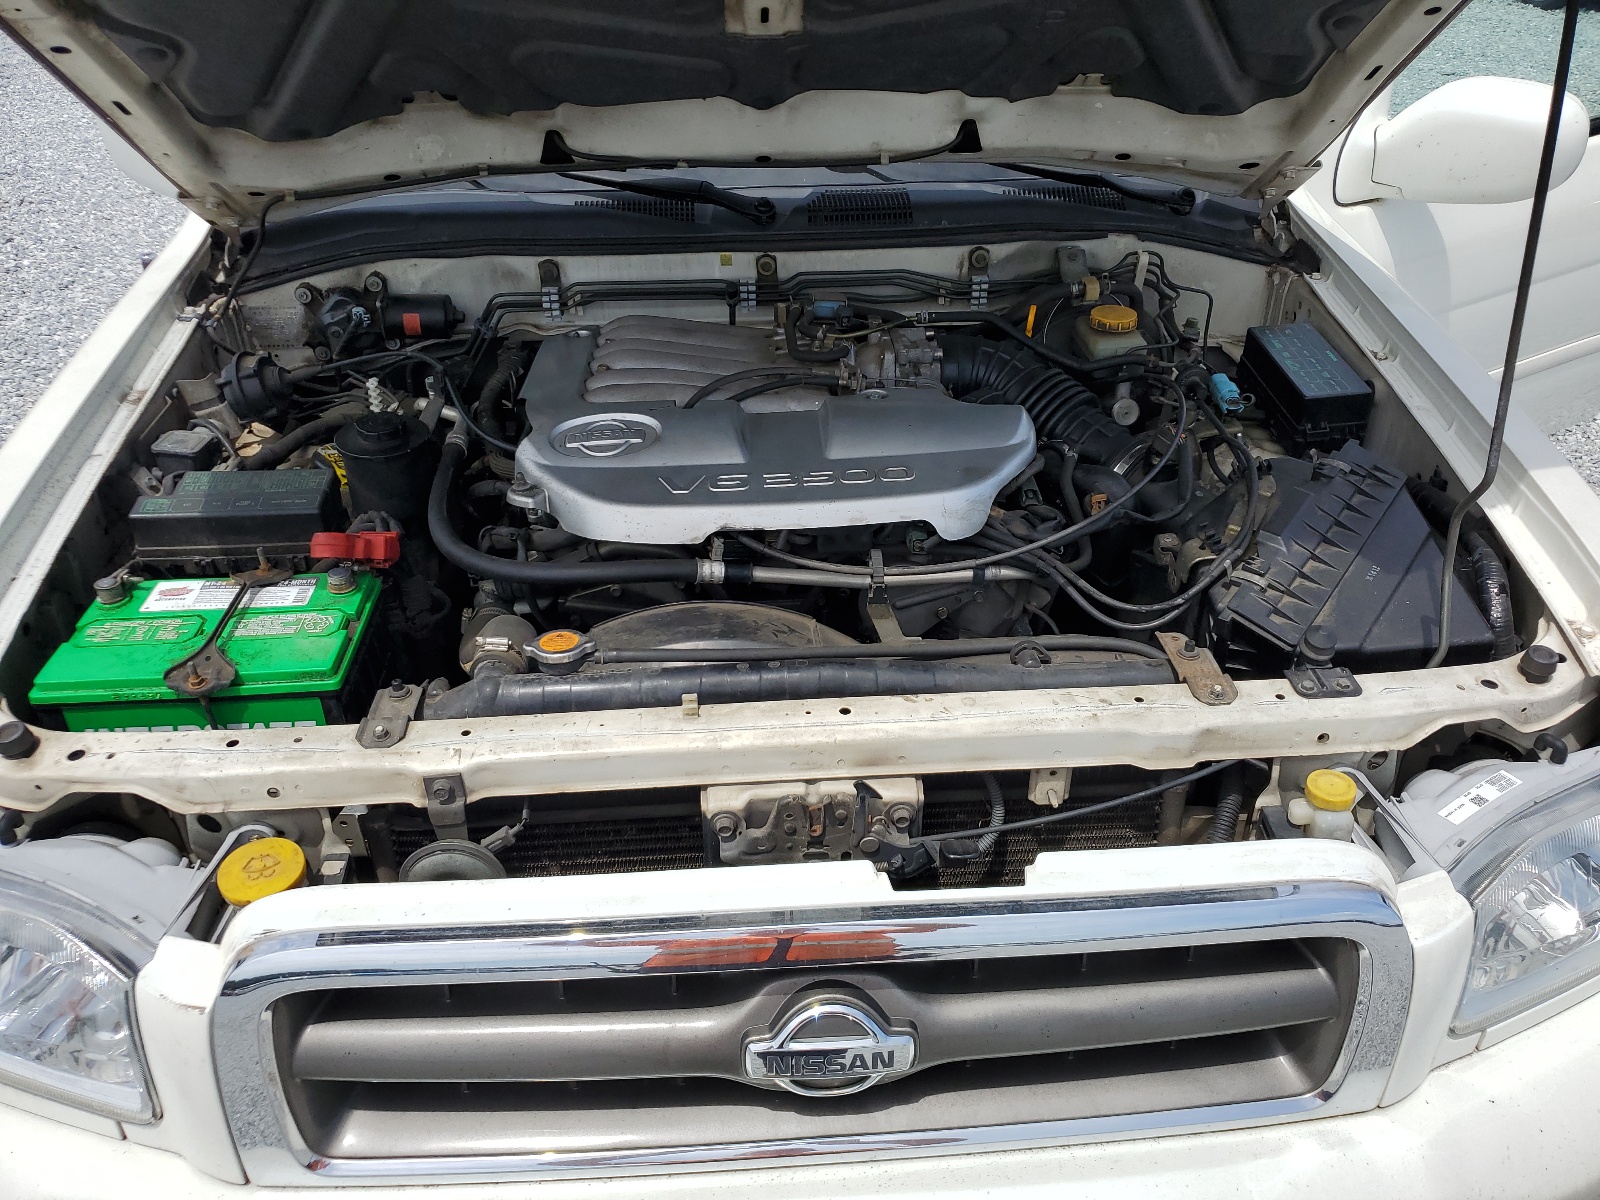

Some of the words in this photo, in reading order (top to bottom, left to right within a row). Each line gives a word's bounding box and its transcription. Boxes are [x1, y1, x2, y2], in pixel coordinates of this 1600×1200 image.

[574, 428, 633, 442] NISSAN
[658, 474, 750, 494] V6
[762, 467, 916, 488] 3500
[766, 1050, 894, 1076] NISSAN
